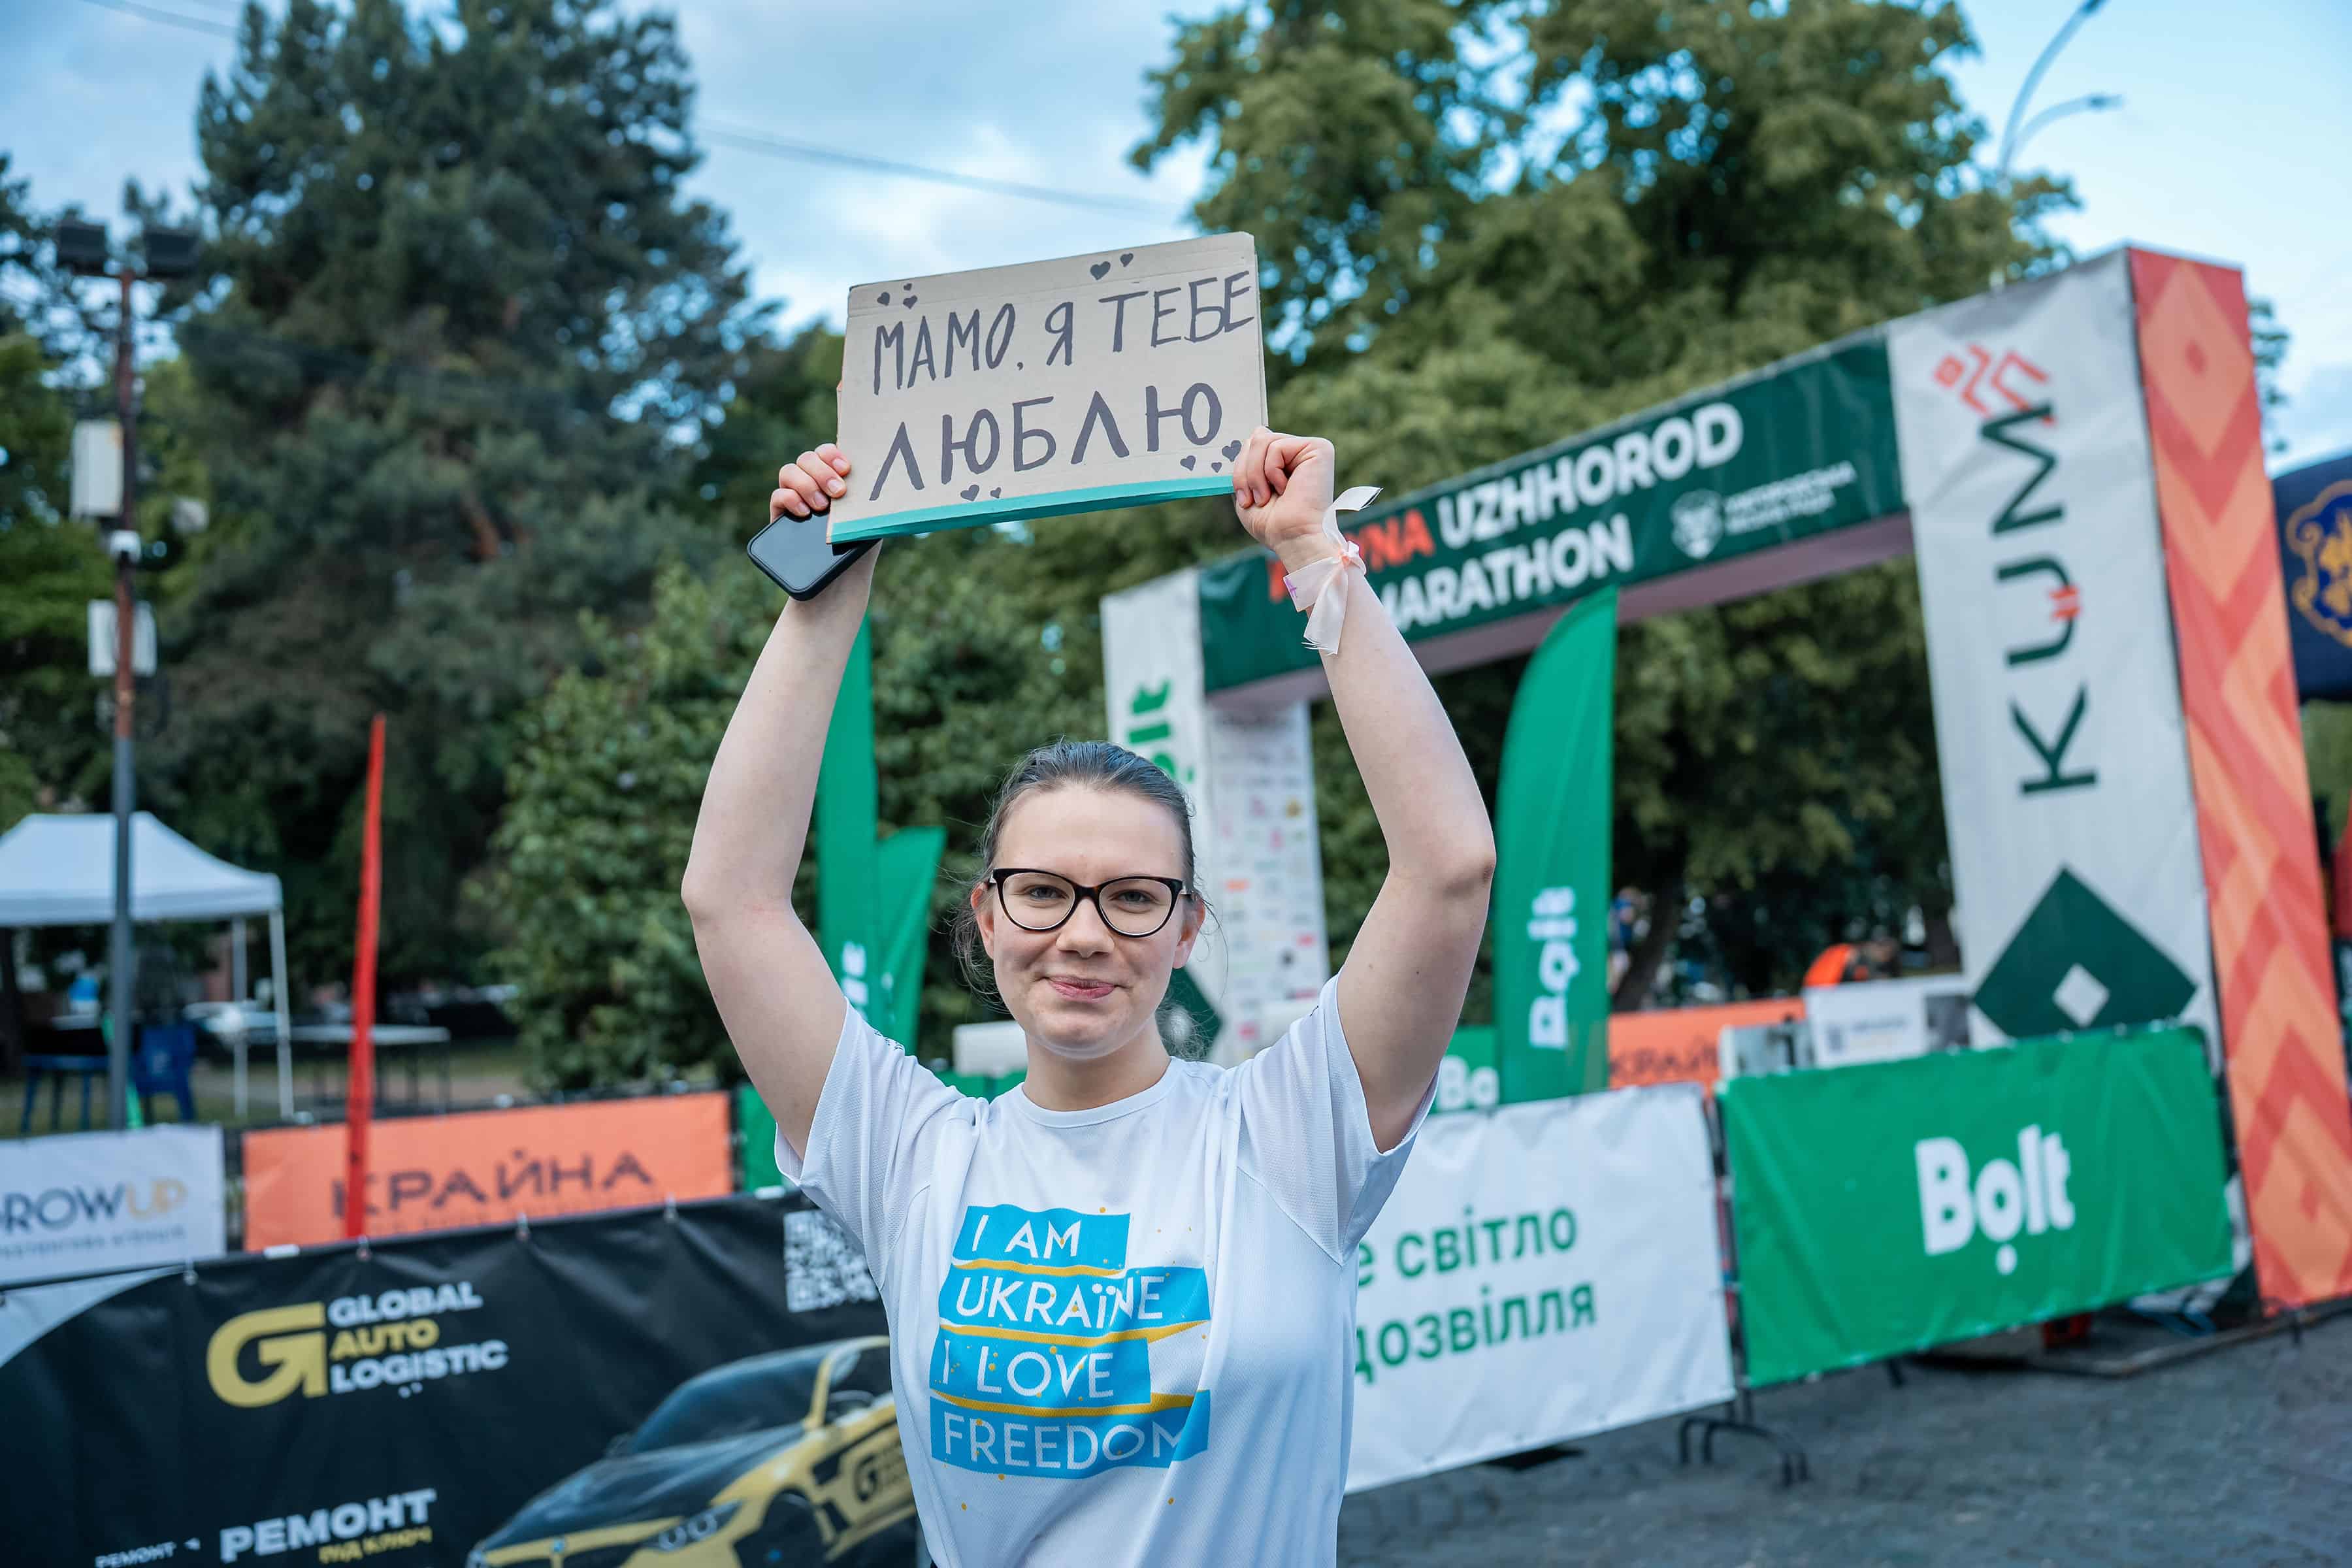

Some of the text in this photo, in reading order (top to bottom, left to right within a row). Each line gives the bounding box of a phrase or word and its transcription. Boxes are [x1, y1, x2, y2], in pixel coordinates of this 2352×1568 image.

[1045, 301, 1075, 367] Я
[1098, 270, 1255, 353] ТЕБЕ
[869, 382, 1223, 501] ЛЮБЛЮ
[1437, 402, 1744, 549] UZHHOROD
[0, 1177, 188, 1237] ROWUP
[1914, 1124, 2076, 1276] Bolt
[972, 1215, 1082, 1260] I AM
[1395, 1205, 1579, 1279] світло
[328, 1281, 483, 1329] GLOBAL
[329, 1318, 440, 1360] AUTO
[329, 1339, 509, 1394] LOGISTIC
[942, 1339, 1114, 1398] I LOVE
[220, 1487, 437, 1563] РЕМОНТ
